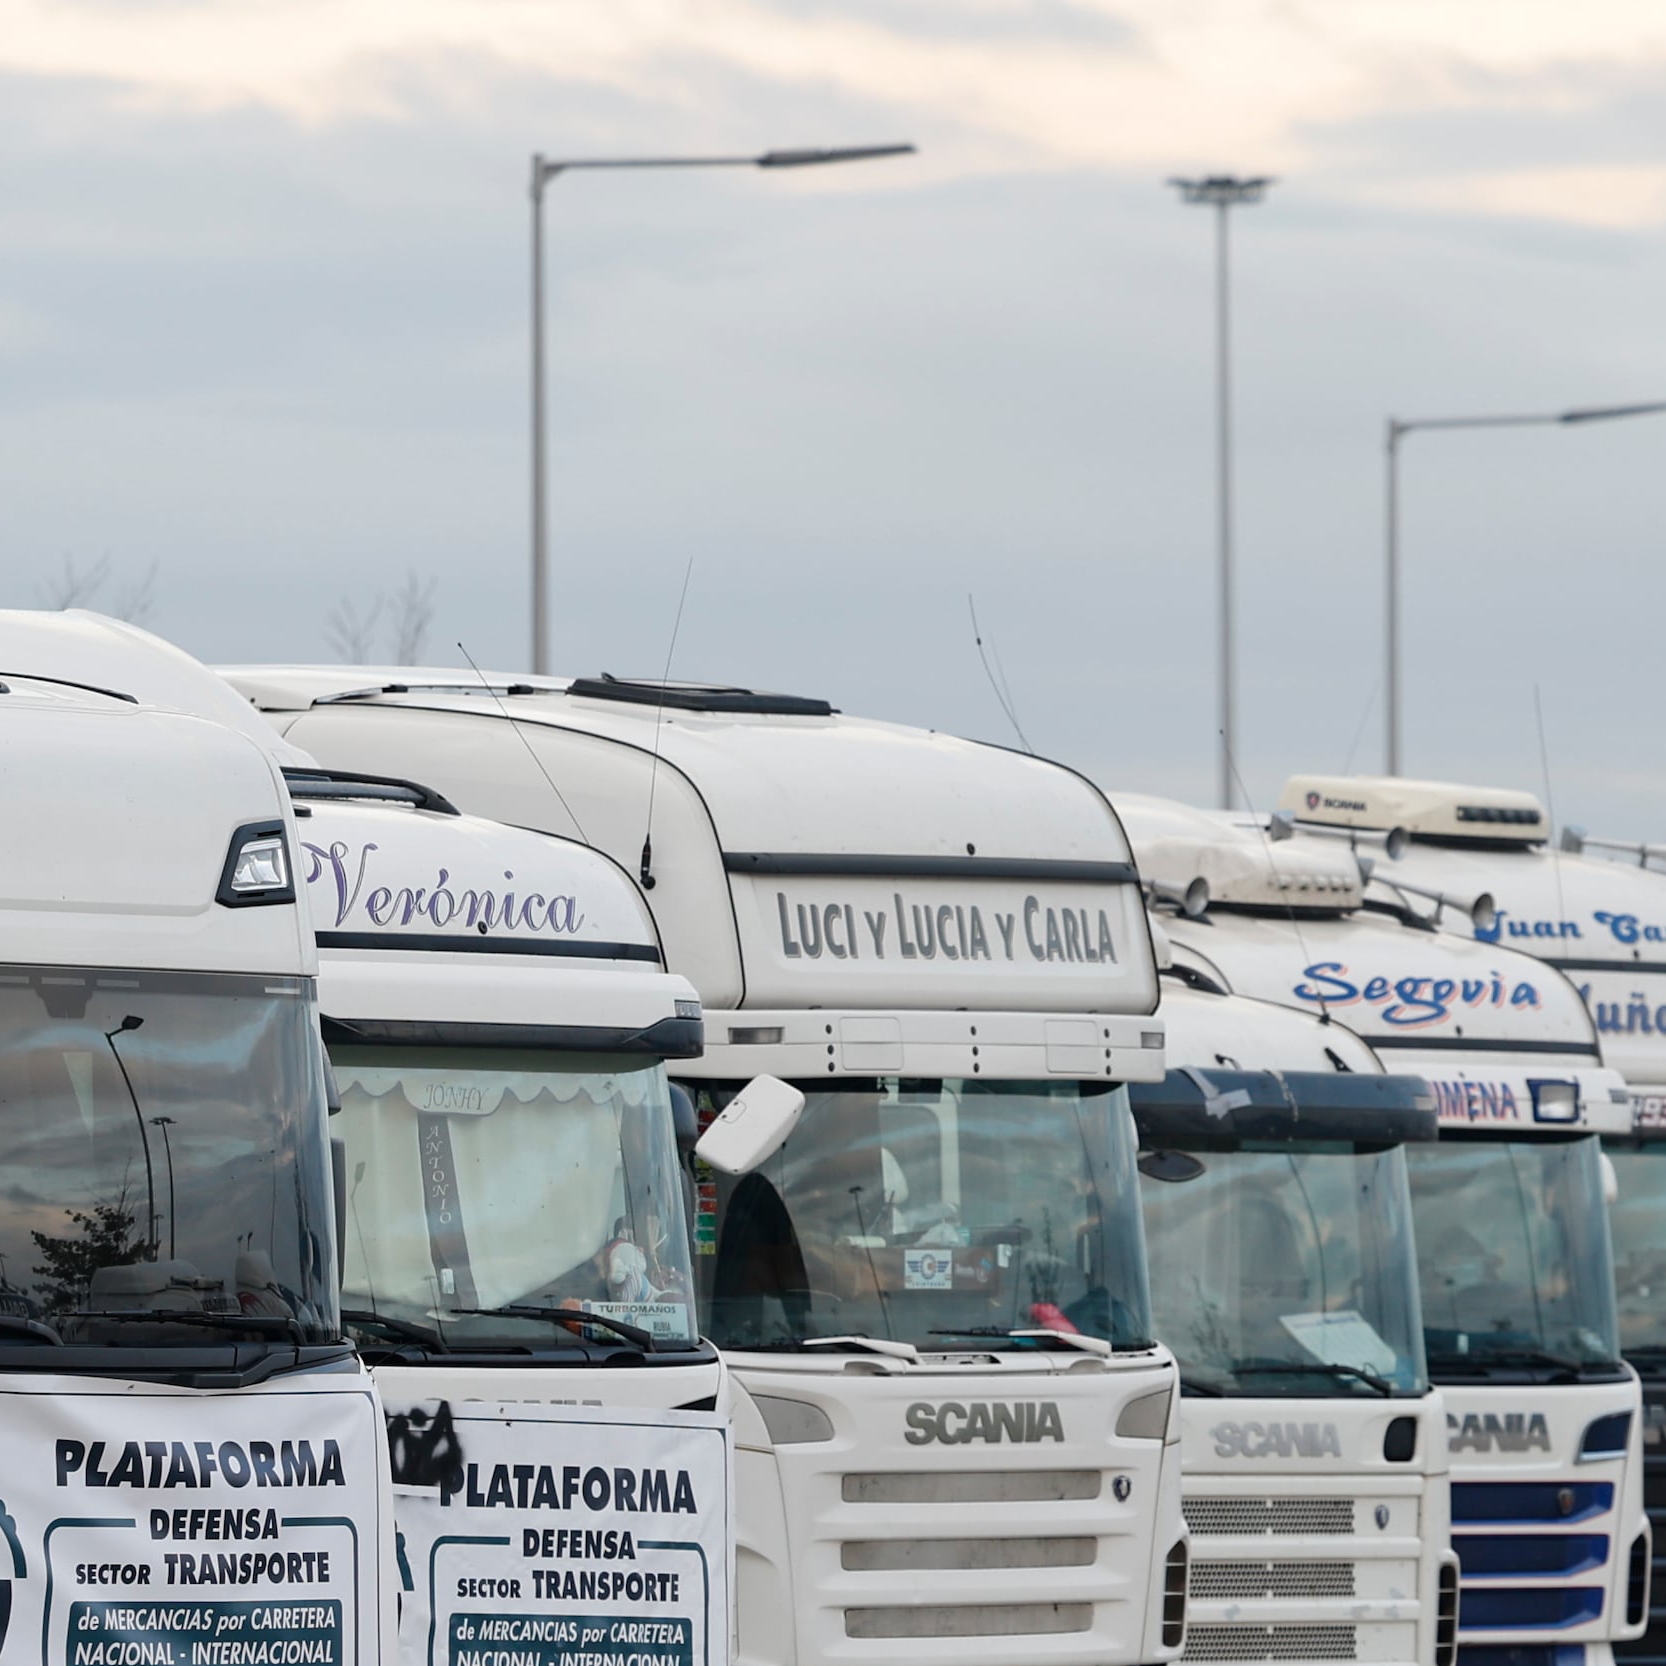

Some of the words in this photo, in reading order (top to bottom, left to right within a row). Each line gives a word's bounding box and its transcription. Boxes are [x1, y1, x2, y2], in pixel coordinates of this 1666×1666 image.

[301, 840, 585, 934] Verónica
[777, 892, 858, 959] LUCI
[893, 893, 991, 961] LUCIA
[1023, 895, 1117, 964] CARLA
[1473, 910, 1583, 943] Juan
[1294, 961, 1542, 1028] Segovia
[426, 1125, 451, 1224] ANTONIO
[904, 1401, 1065, 1445] SCANIA
[1210, 1422, 1341, 1457] SCANIA
[55, 1439, 346, 1488] PLATAFORMA
[440, 1463, 697, 1514] PLATAFORMA
[150, 1508, 278, 1540] DEFENSA
[523, 1529, 636, 1559] DEFENSA
[76, 1563, 150, 1585] SECTOR
[164, 1552, 330, 1585] TRANSPORTE
[457, 1578, 521, 1598] SECTOR
[533, 1571, 679, 1602] TRANSPORTE
[78, 1610, 99, 1632] de
[105, 1608, 213, 1631] MERCANCIAS
[216, 1613, 246, 1636] por
[250, 1606, 335, 1630] CARRETERA
[456, 1619, 474, 1641] de
[479, 1620, 577, 1642] MERCANCIAS
[581, 1627, 606, 1647] por
[610, 1623, 684, 1644] CARRETERA
[75, 1643, 174, 1666] NACIONAL
[192, 1640, 334, 1664] INTERNACIONAL
